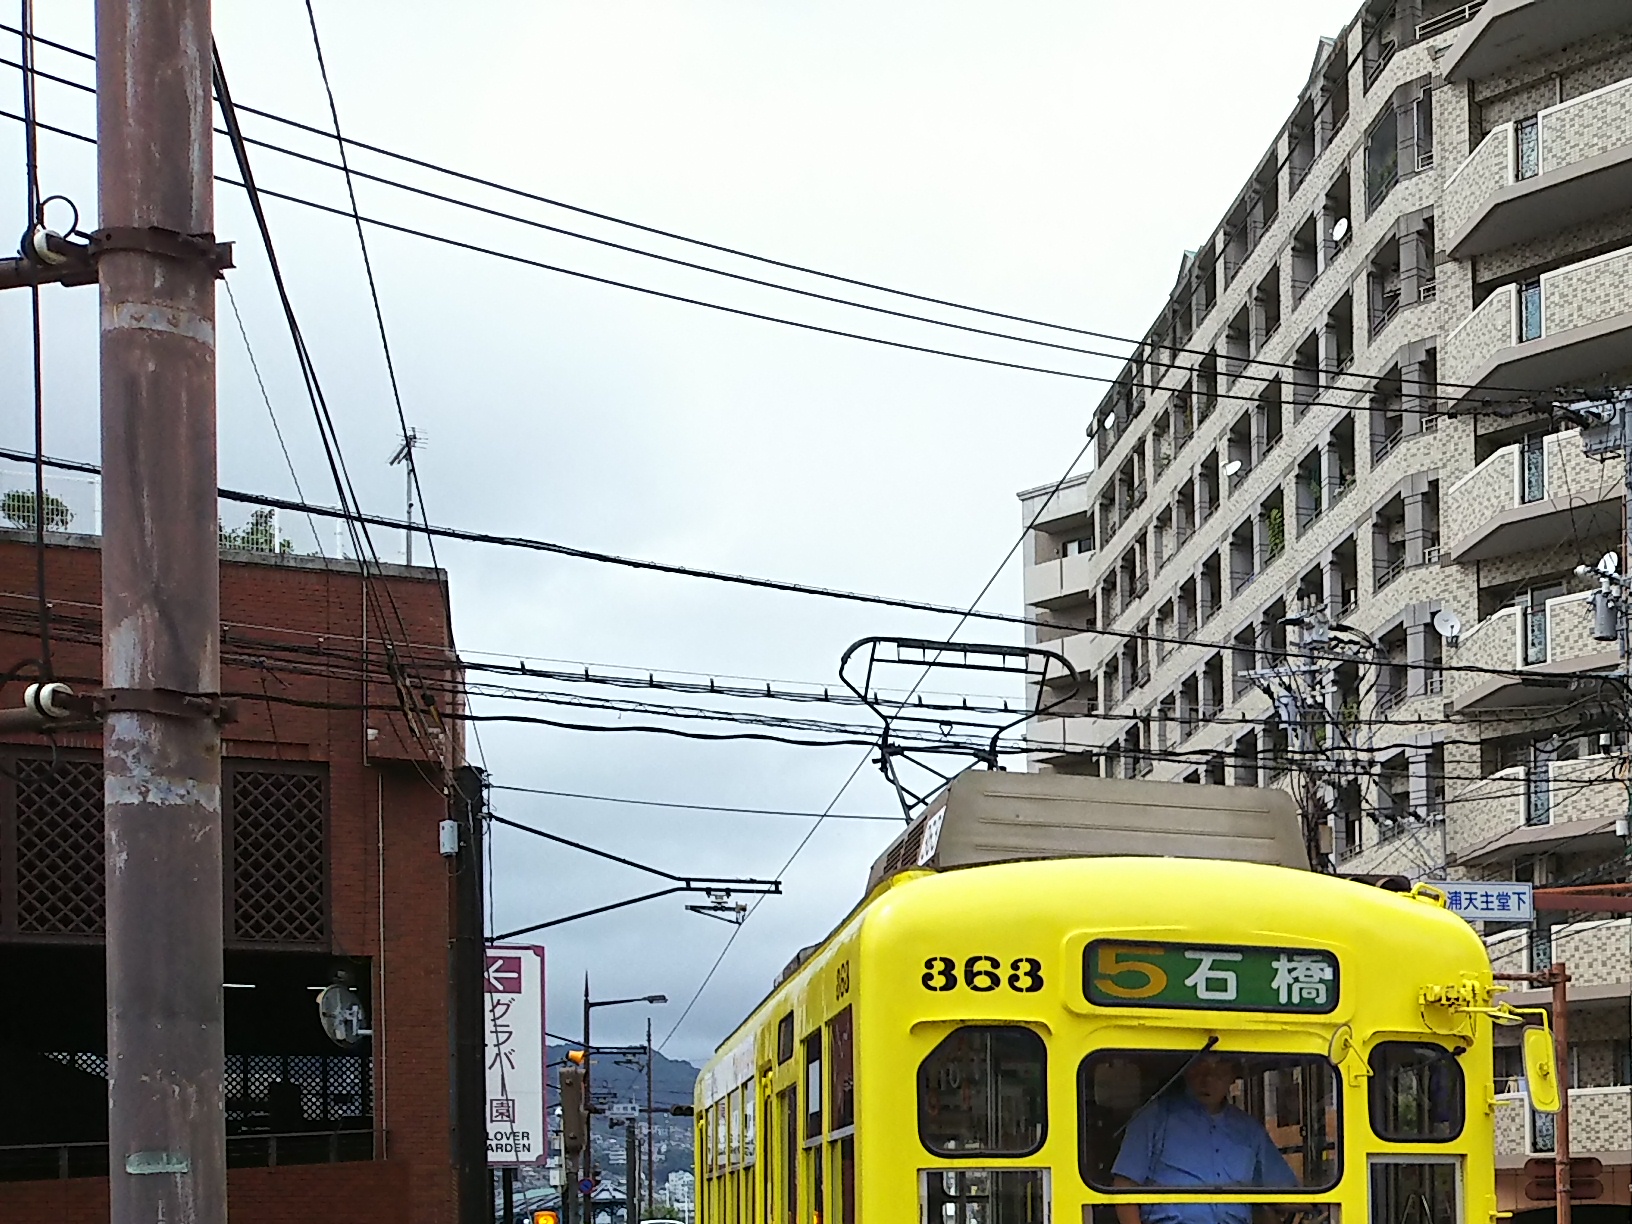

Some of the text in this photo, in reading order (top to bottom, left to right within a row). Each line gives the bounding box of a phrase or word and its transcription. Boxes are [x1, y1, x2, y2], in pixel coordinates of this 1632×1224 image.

[1447, 890, 1527, 912] 浦天主堂下
[836, 960, 850, 1002] 363
[921, 956, 1045, 993] 363
[1093, 947, 1330, 1005] 5 石橋
[488, 997, 516, 1124] グラバー園
[486, 1131, 530, 1142] LOVER
[486, 1143, 531, 1153] ARDEN
